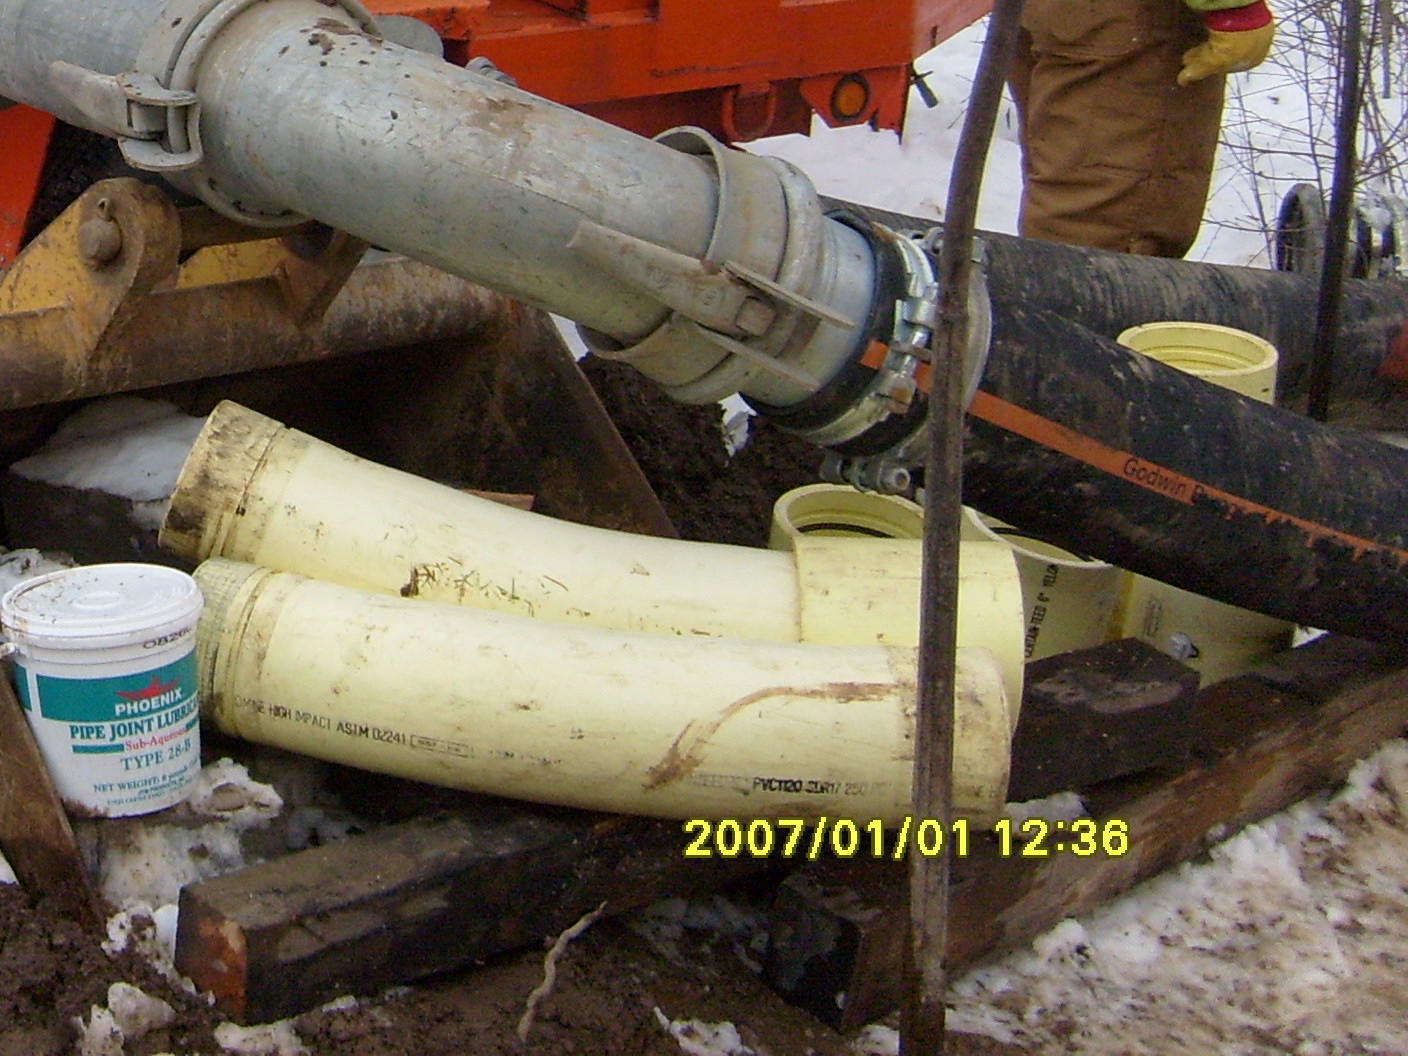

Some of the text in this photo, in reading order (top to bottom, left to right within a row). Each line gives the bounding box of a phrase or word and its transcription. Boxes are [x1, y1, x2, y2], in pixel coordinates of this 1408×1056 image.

[1124, 457, 1186, 495] Godwin
[114, 687, 183, 717] PHOENIX
[69, 722, 106, 740] PIPE
[109, 717, 154, 742] JOINT
[337, 720, 369, 739] ASTM
[120, 748, 163, 771] TYPE
[169, 738, 191, 760] 28-B
[93, 783, 114, 793] NET
